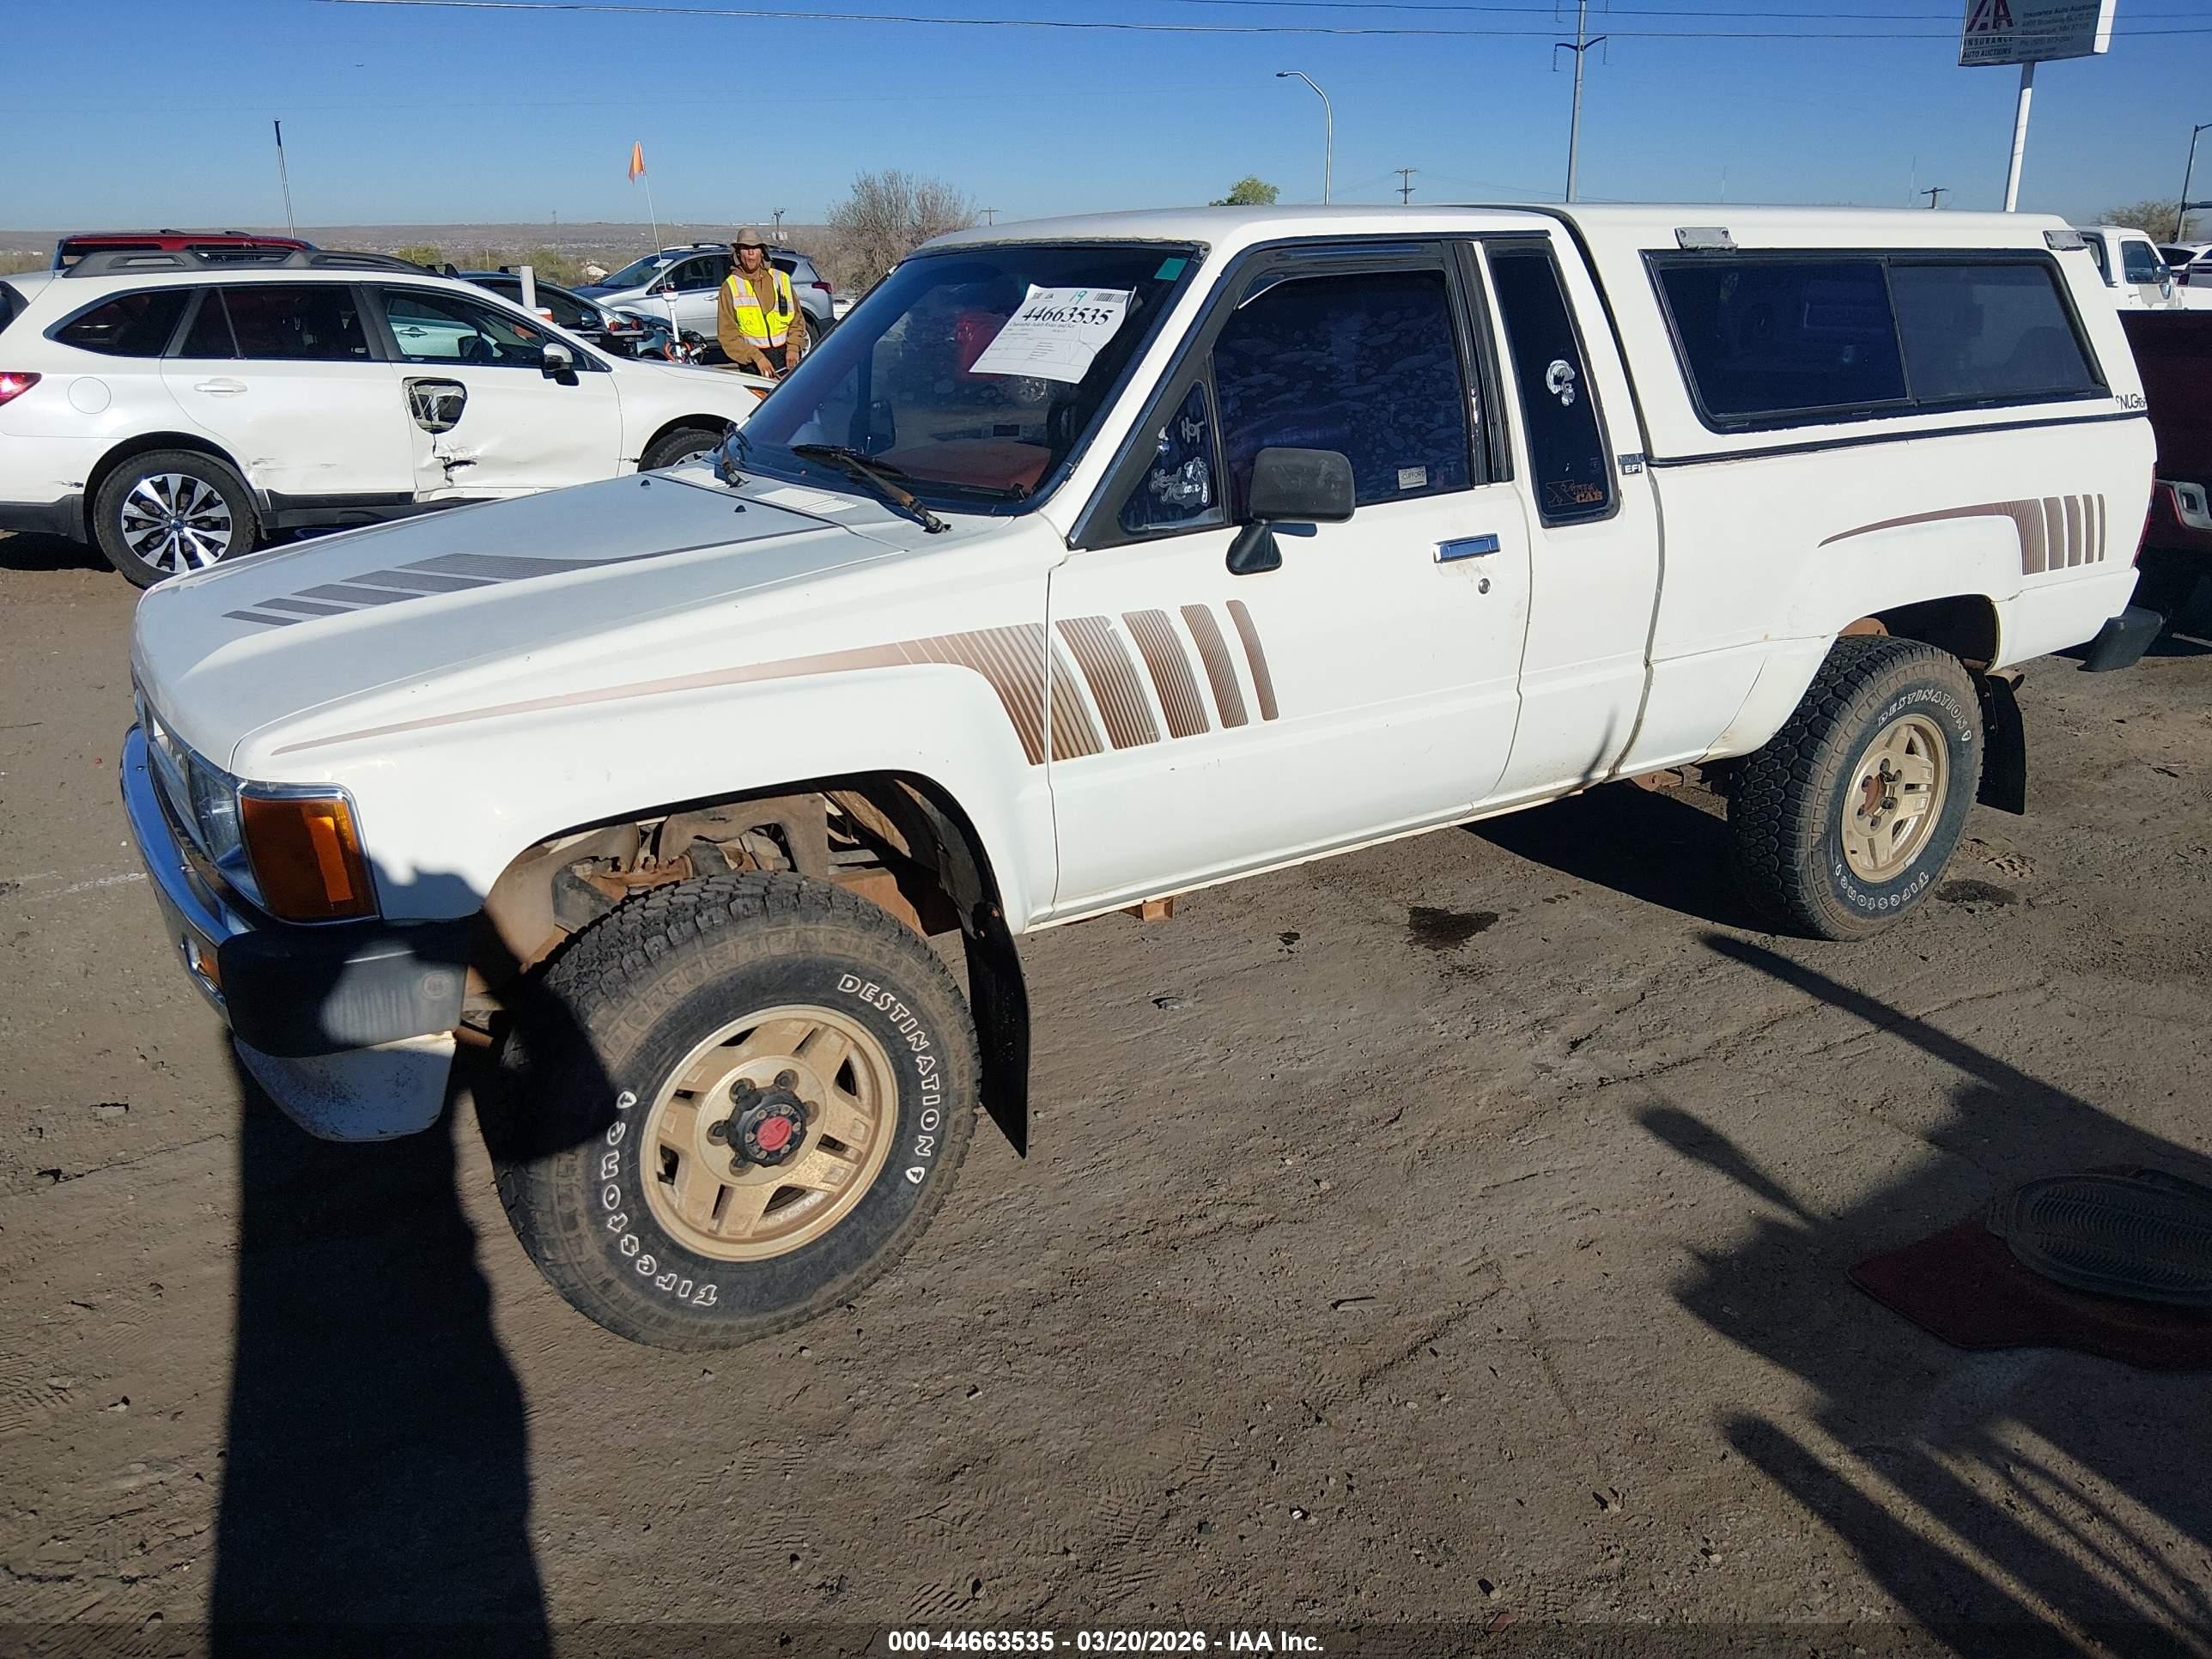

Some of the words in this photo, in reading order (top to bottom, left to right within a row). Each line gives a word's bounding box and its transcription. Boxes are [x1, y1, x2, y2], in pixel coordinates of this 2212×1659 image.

[1962, 51, 1979, 59] AUTO
[1980, 48, 2012, 57] AUCTIONS
[1069, 290, 1087, 306] 19
[1022, 307, 1115, 325] 44663535
[1625, 464, 1642, 473] EFI
[1577, 490, 1603, 503] CAB
[1878, 688, 1968, 730] DESTINATION
[836, 973, 941, 1158] DESTINATION
[600, 1117, 719, 1306] Firestone
